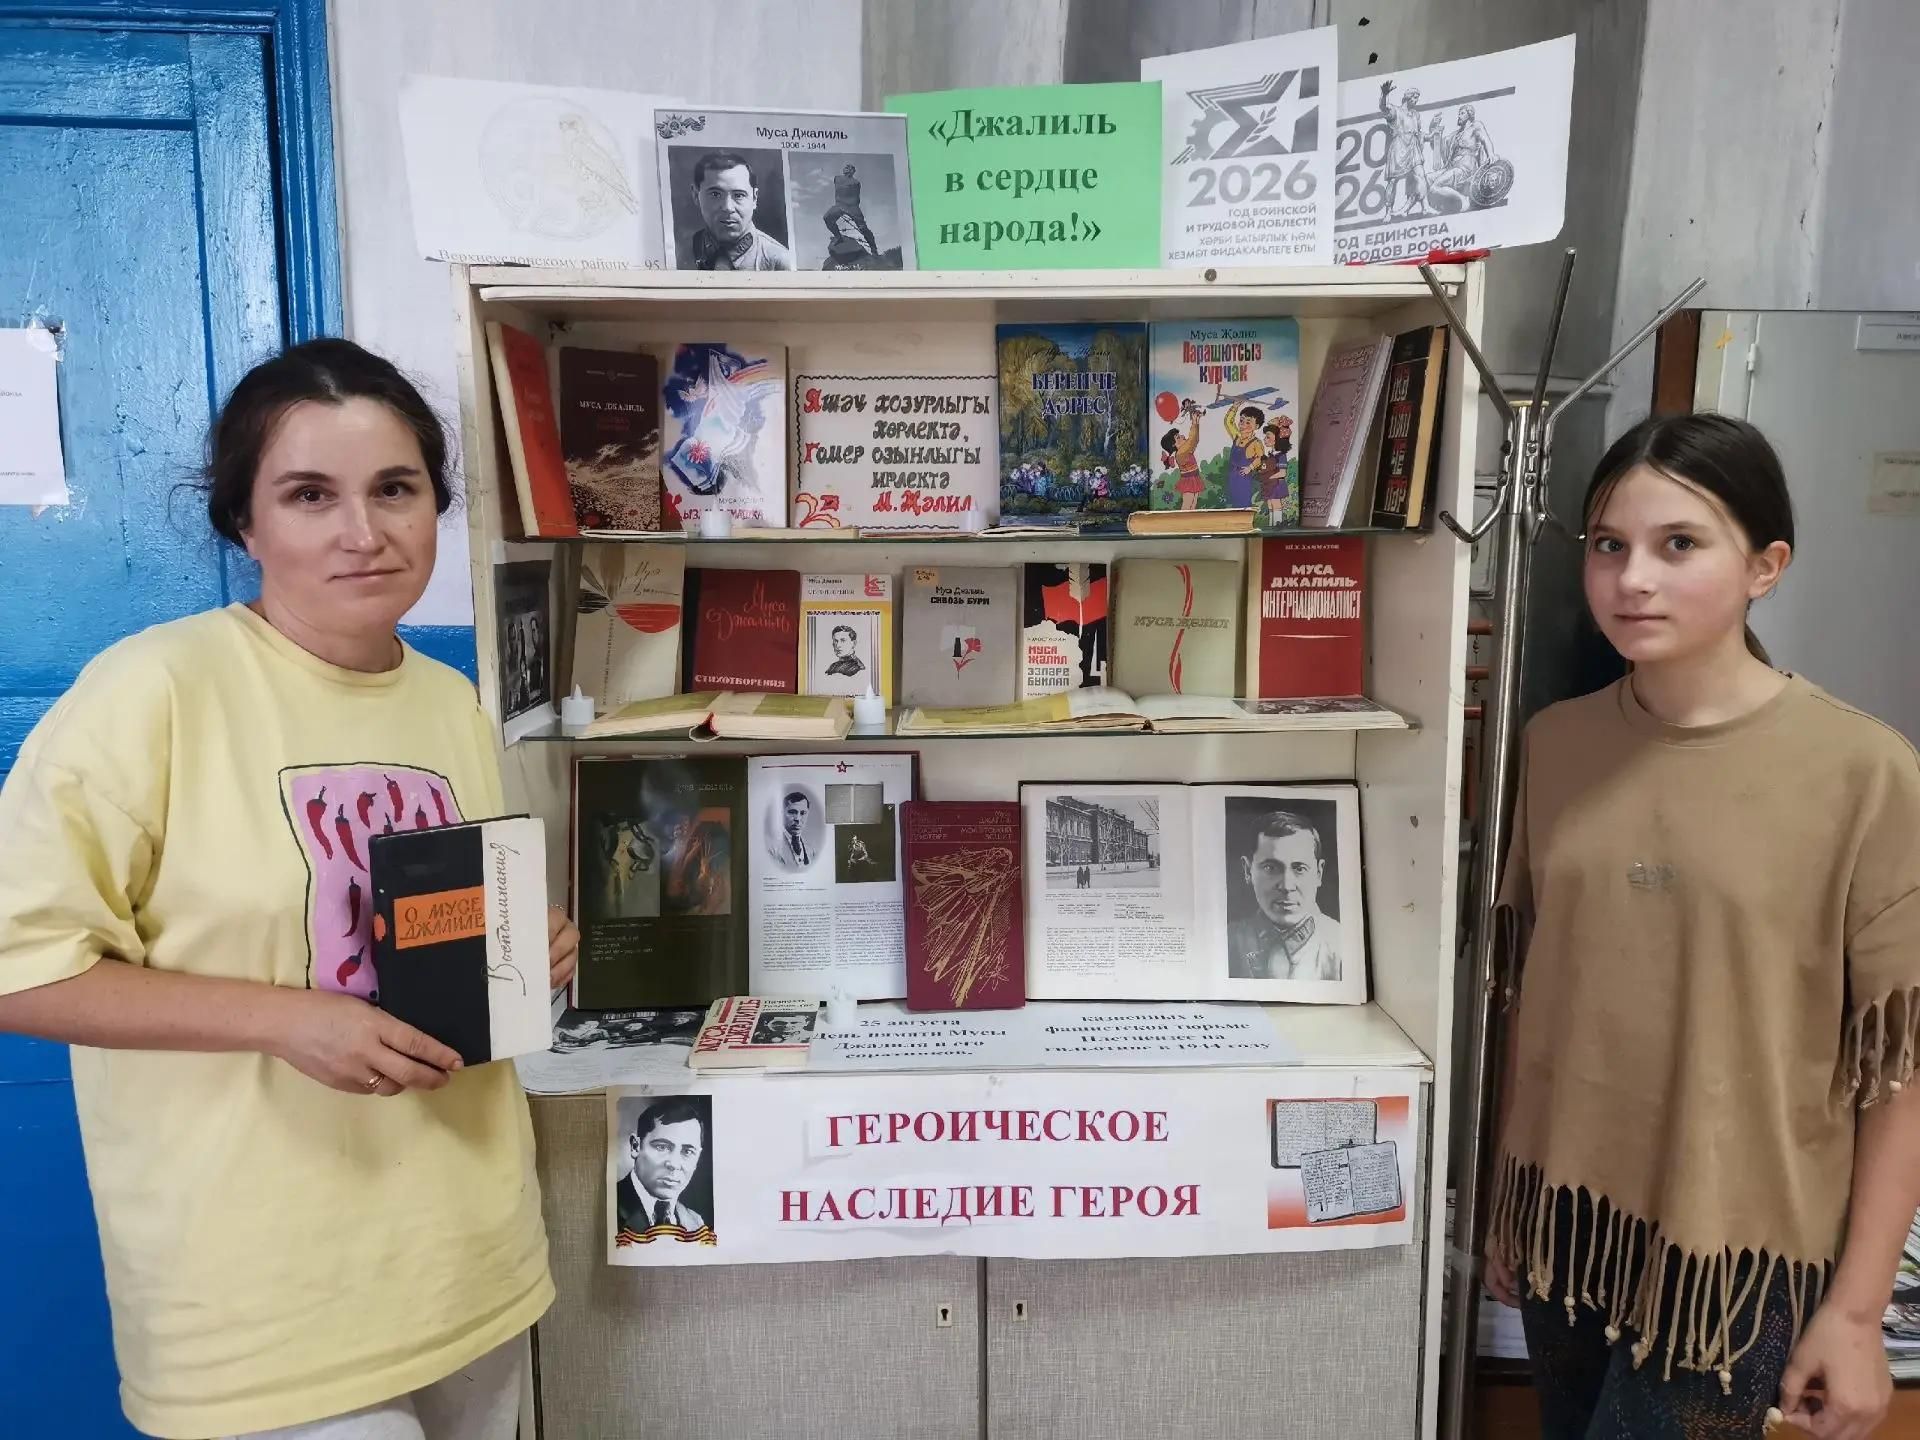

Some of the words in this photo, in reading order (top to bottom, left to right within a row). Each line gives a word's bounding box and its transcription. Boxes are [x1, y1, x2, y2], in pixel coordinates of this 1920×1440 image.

[756, 127, 788, 140] Муса
[792, 128, 848, 140] Джалиль
[928, 109, 1117, 147] «Джалиль
[945, 172, 965, 193] в
[976, 167, 1098, 199] сердце
[1186, 159, 1318, 208] 2026
[1228, 208, 1250, 218] ГОД
[1252, 203, 1317, 216] ВОИНСКОЙ
[939, 211, 1101, 251] народа!»
[1186, 224, 1195, 233] И
[1196, 219, 1255, 233] ТРУДОВОЙ
[1257, 217, 1316, 230] ДОБЛЕСТИ
[1334, 237, 1360, 250] ОД
[1364, 222, 1449, 247] ЕДИНСТВА
[1294, 243, 1316, 254] ЕЛЫ
[1407, 233, 1476, 255] РОССИИ
[1190, 329, 1218, 342] Муса
[1182, 341, 1262, 366] Парашютсыз
[1031, 371, 1117, 391] БЕРЕНЧЕ
[579, 400, 602, 410] МУСА
[1291, 564, 1335, 576] МУСА
[935, 585, 953, 596] Муса
[930, 596, 965, 605] СКВОЗЬ
[967, 597, 990, 606] БУРИ
[1262, 590, 1362, 621] ИНТЕРНАЦИОНАЛИСТ
[1132, 615, 1175, 628] МУСА
[1028, 645, 1058, 655] МУСА
[694, 674, 787, 688] СТИХОТВОРЕНИЯ
[404, 905, 418, 925] О
[428, 896, 482, 920] МУСЕ
[399, 913, 485, 941] ДЖАЛИЛЕ
[887, 1019, 961, 1027] августа
[1044, 1023, 1170, 1034] фашистской
[1173, 1022, 1252, 1032] тюрьме
[812, 1032, 862, 1040] День
[868, 1030, 942, 1039] памяти
[949, 1029, 1007, 1037] Мусы
[833, 1042, 928, 1050] Джалиля
[1177, 1042, 1222, 1050] 1944
[825, 1109, 1169, 1148] ГЕРОИЧЕСКОЕ
[778, 1184, 1036, 1228] НАСЛЕДИЕ
[1048, 1183, 1201, 1219] ГЕРОЯ
